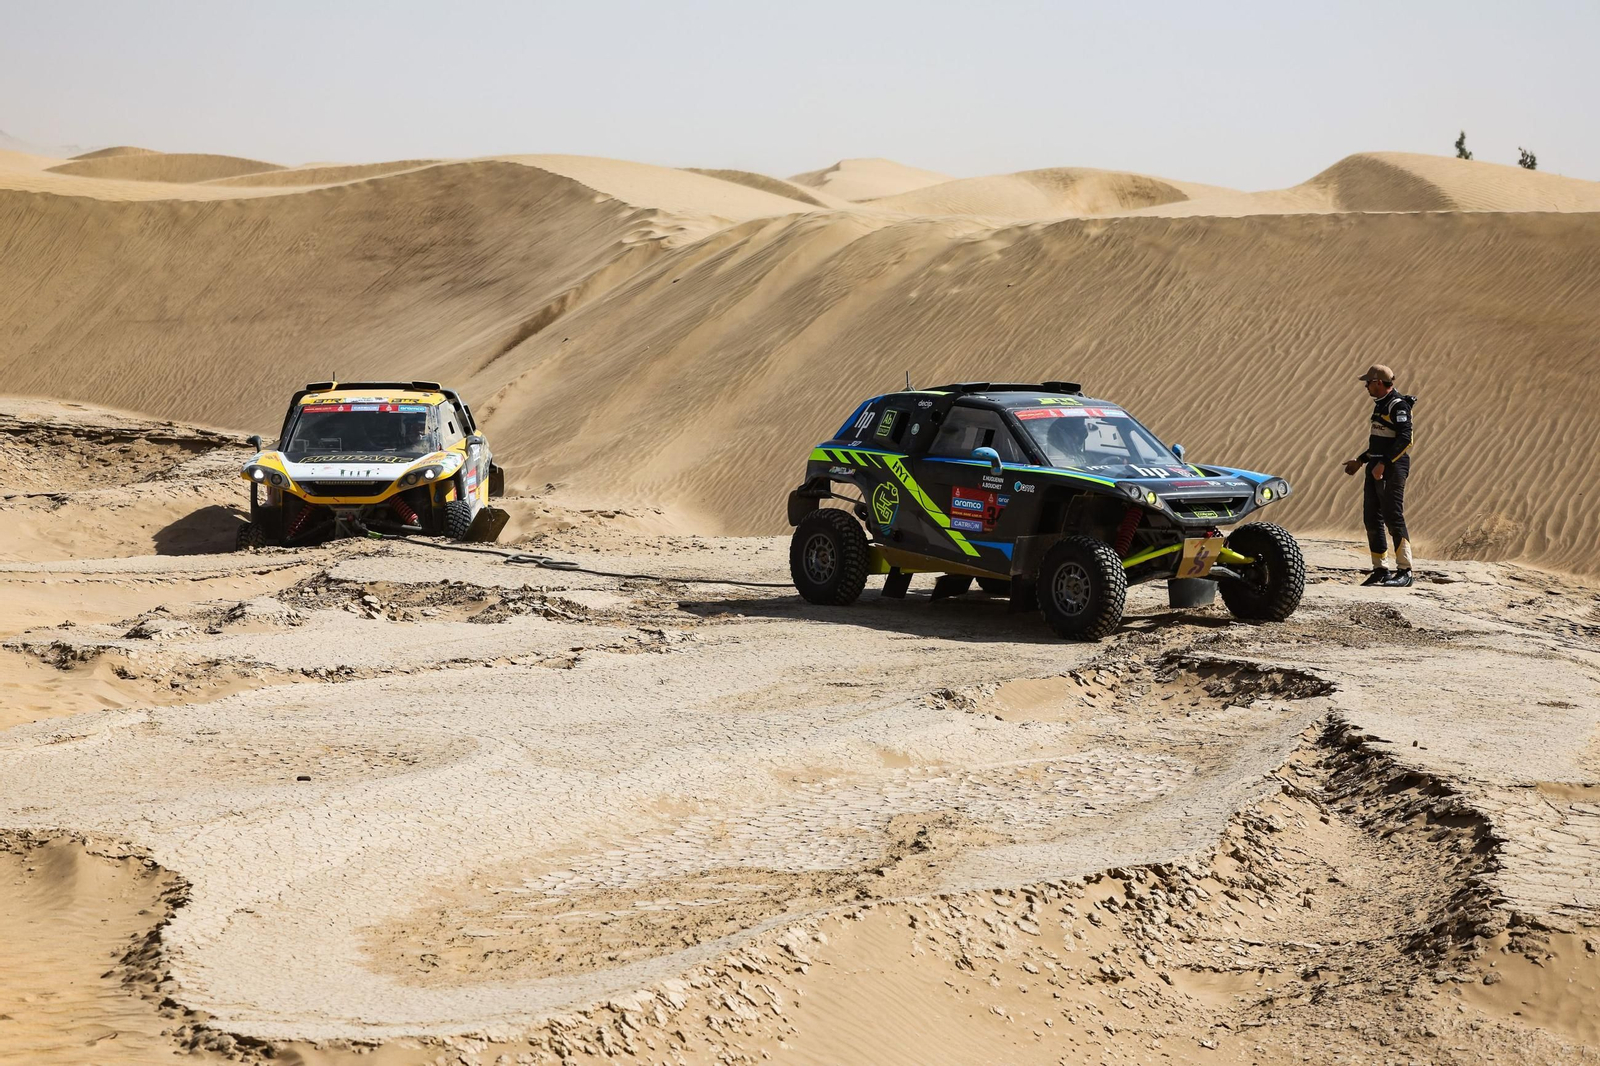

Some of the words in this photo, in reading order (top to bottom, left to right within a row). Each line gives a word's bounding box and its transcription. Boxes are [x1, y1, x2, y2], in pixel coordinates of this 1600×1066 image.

[854, 402, 876, 438] hp
[892, 461, 910, 483] HYT
[1129, 463, 1171, 479] hp
[954, 499, 982, 510] aramco
[953, 520, 980, 530] CATRION
